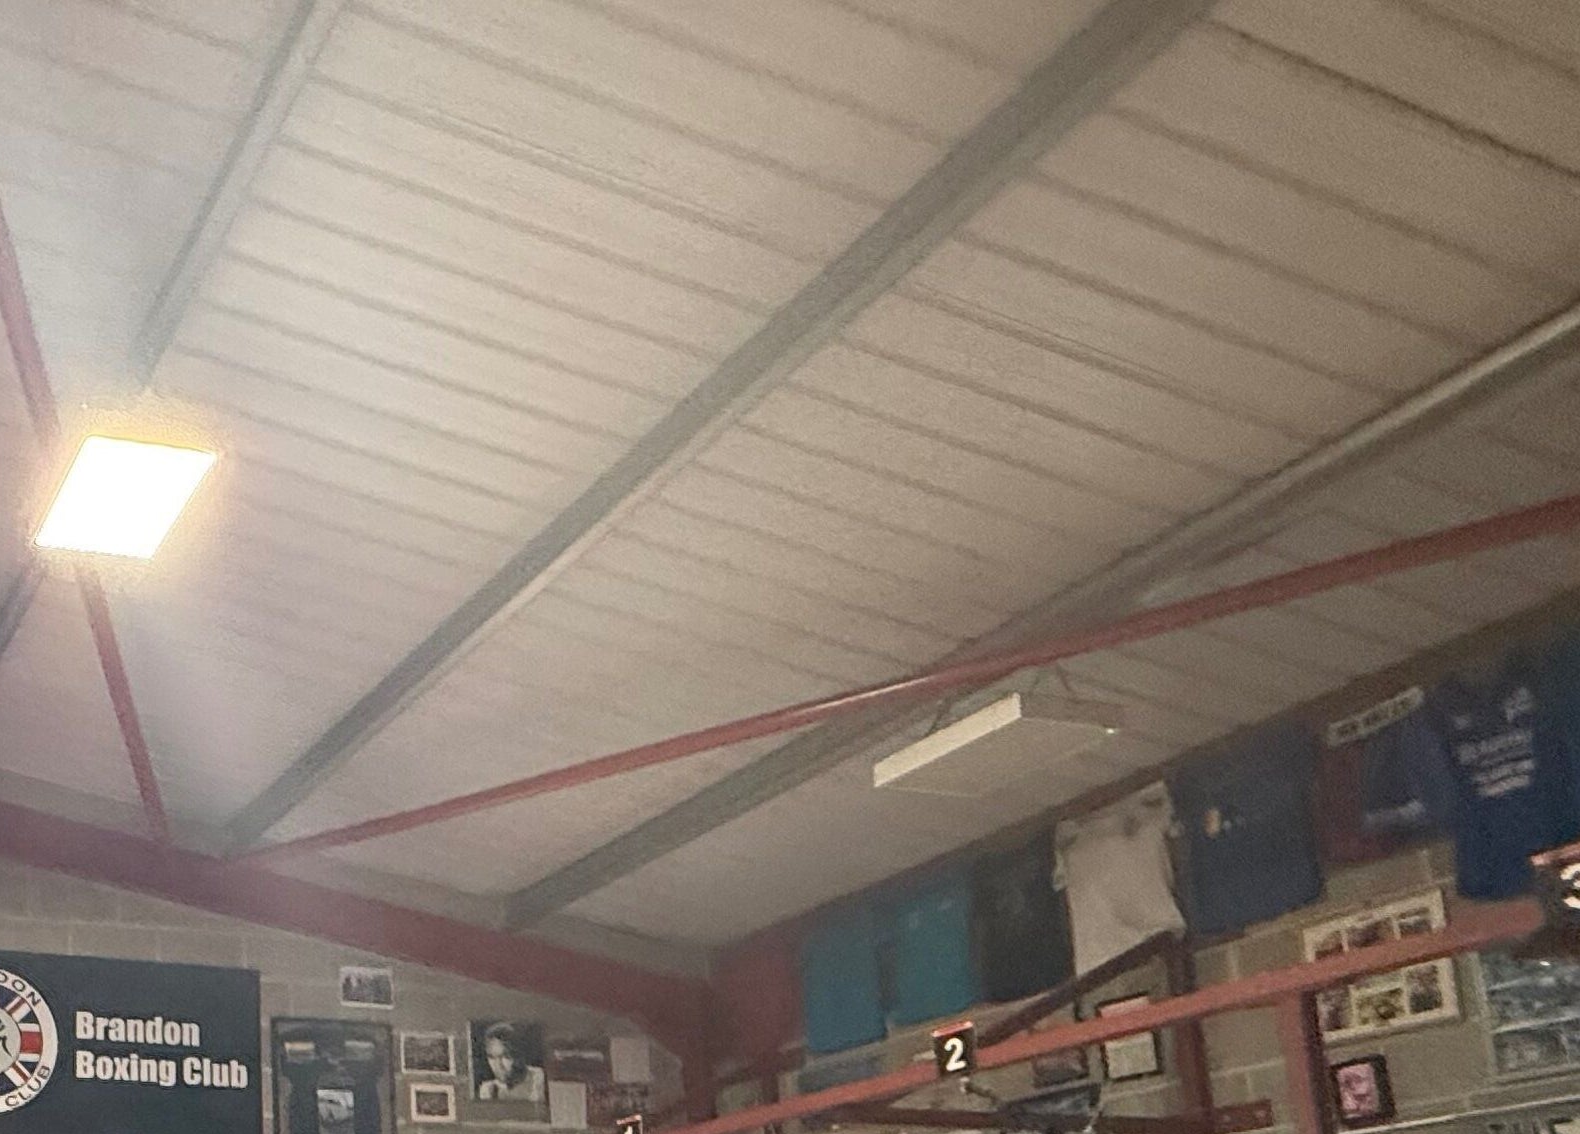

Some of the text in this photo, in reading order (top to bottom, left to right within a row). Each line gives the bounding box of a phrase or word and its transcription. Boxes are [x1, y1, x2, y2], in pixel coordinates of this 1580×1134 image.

[75, 1010, 201, 1048] Brandon
[75, 1050, 249, 1090] Boxing Club
[944, 1037, 968, 1072] 2
[4, 1064, 51, 1110] CLUB
